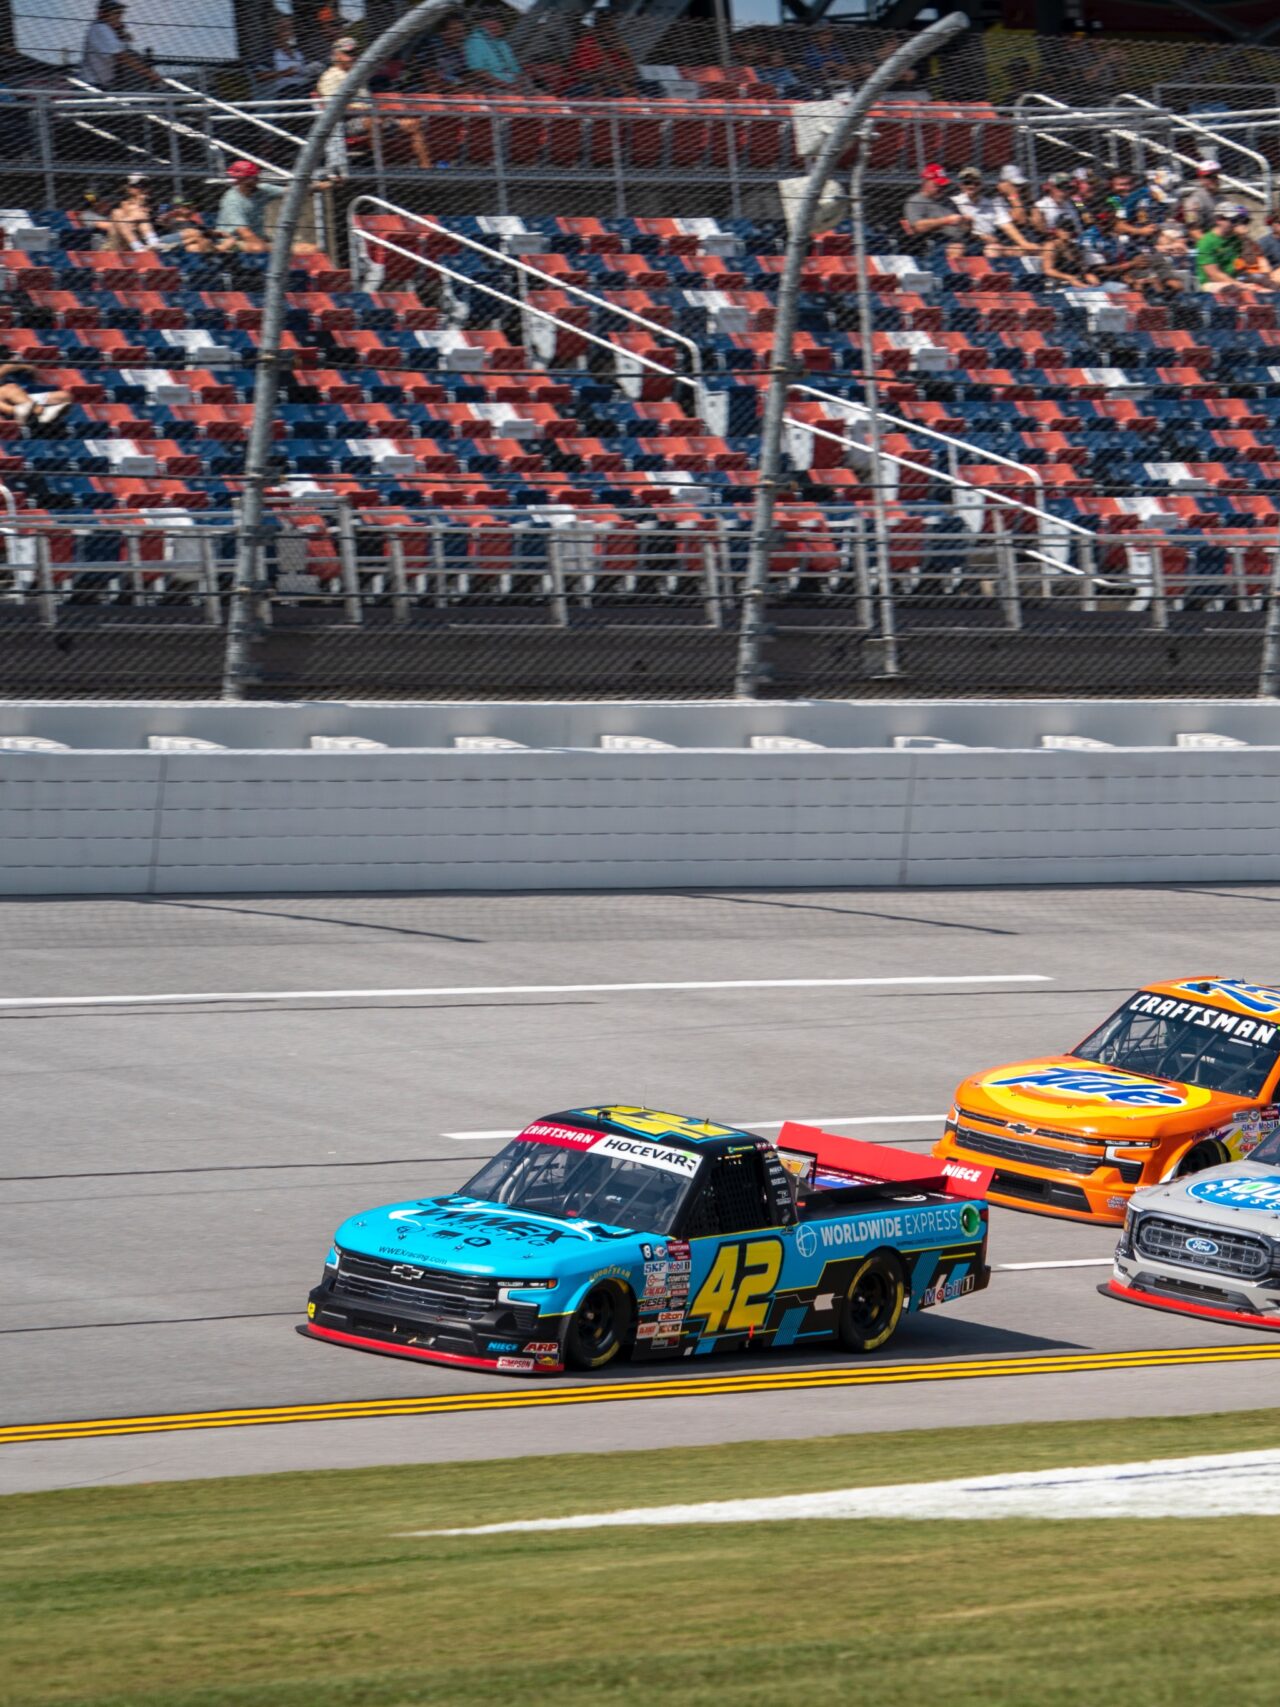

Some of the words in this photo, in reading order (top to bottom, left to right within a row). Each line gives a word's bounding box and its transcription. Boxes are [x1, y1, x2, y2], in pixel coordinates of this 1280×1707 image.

[1130, 993, 1278, 1044] CRAFTSMAN
[523, 1124, 595, 1145] CRAFTSMAN
[603, 1138, 687, 1168] HOCEVAR
[941, 1163, 983, 1183] NIECE
[820, 1216, 902, 1247] WORLDWIDE
[904, 1209, 958, 1235] EXPRESS
[378, 1245, 449, 1266] WWEXracing.com
[642, 1244, 653, 1259] 8
[644, 1263, 666, 1274] SKF
[687, 1237, 785, 1334] 42
[924, 1278, 962, 1306] Mobil
[486, 1341, 519, 1352] NIECE
[523, 1342, 559, 1353] ARP
